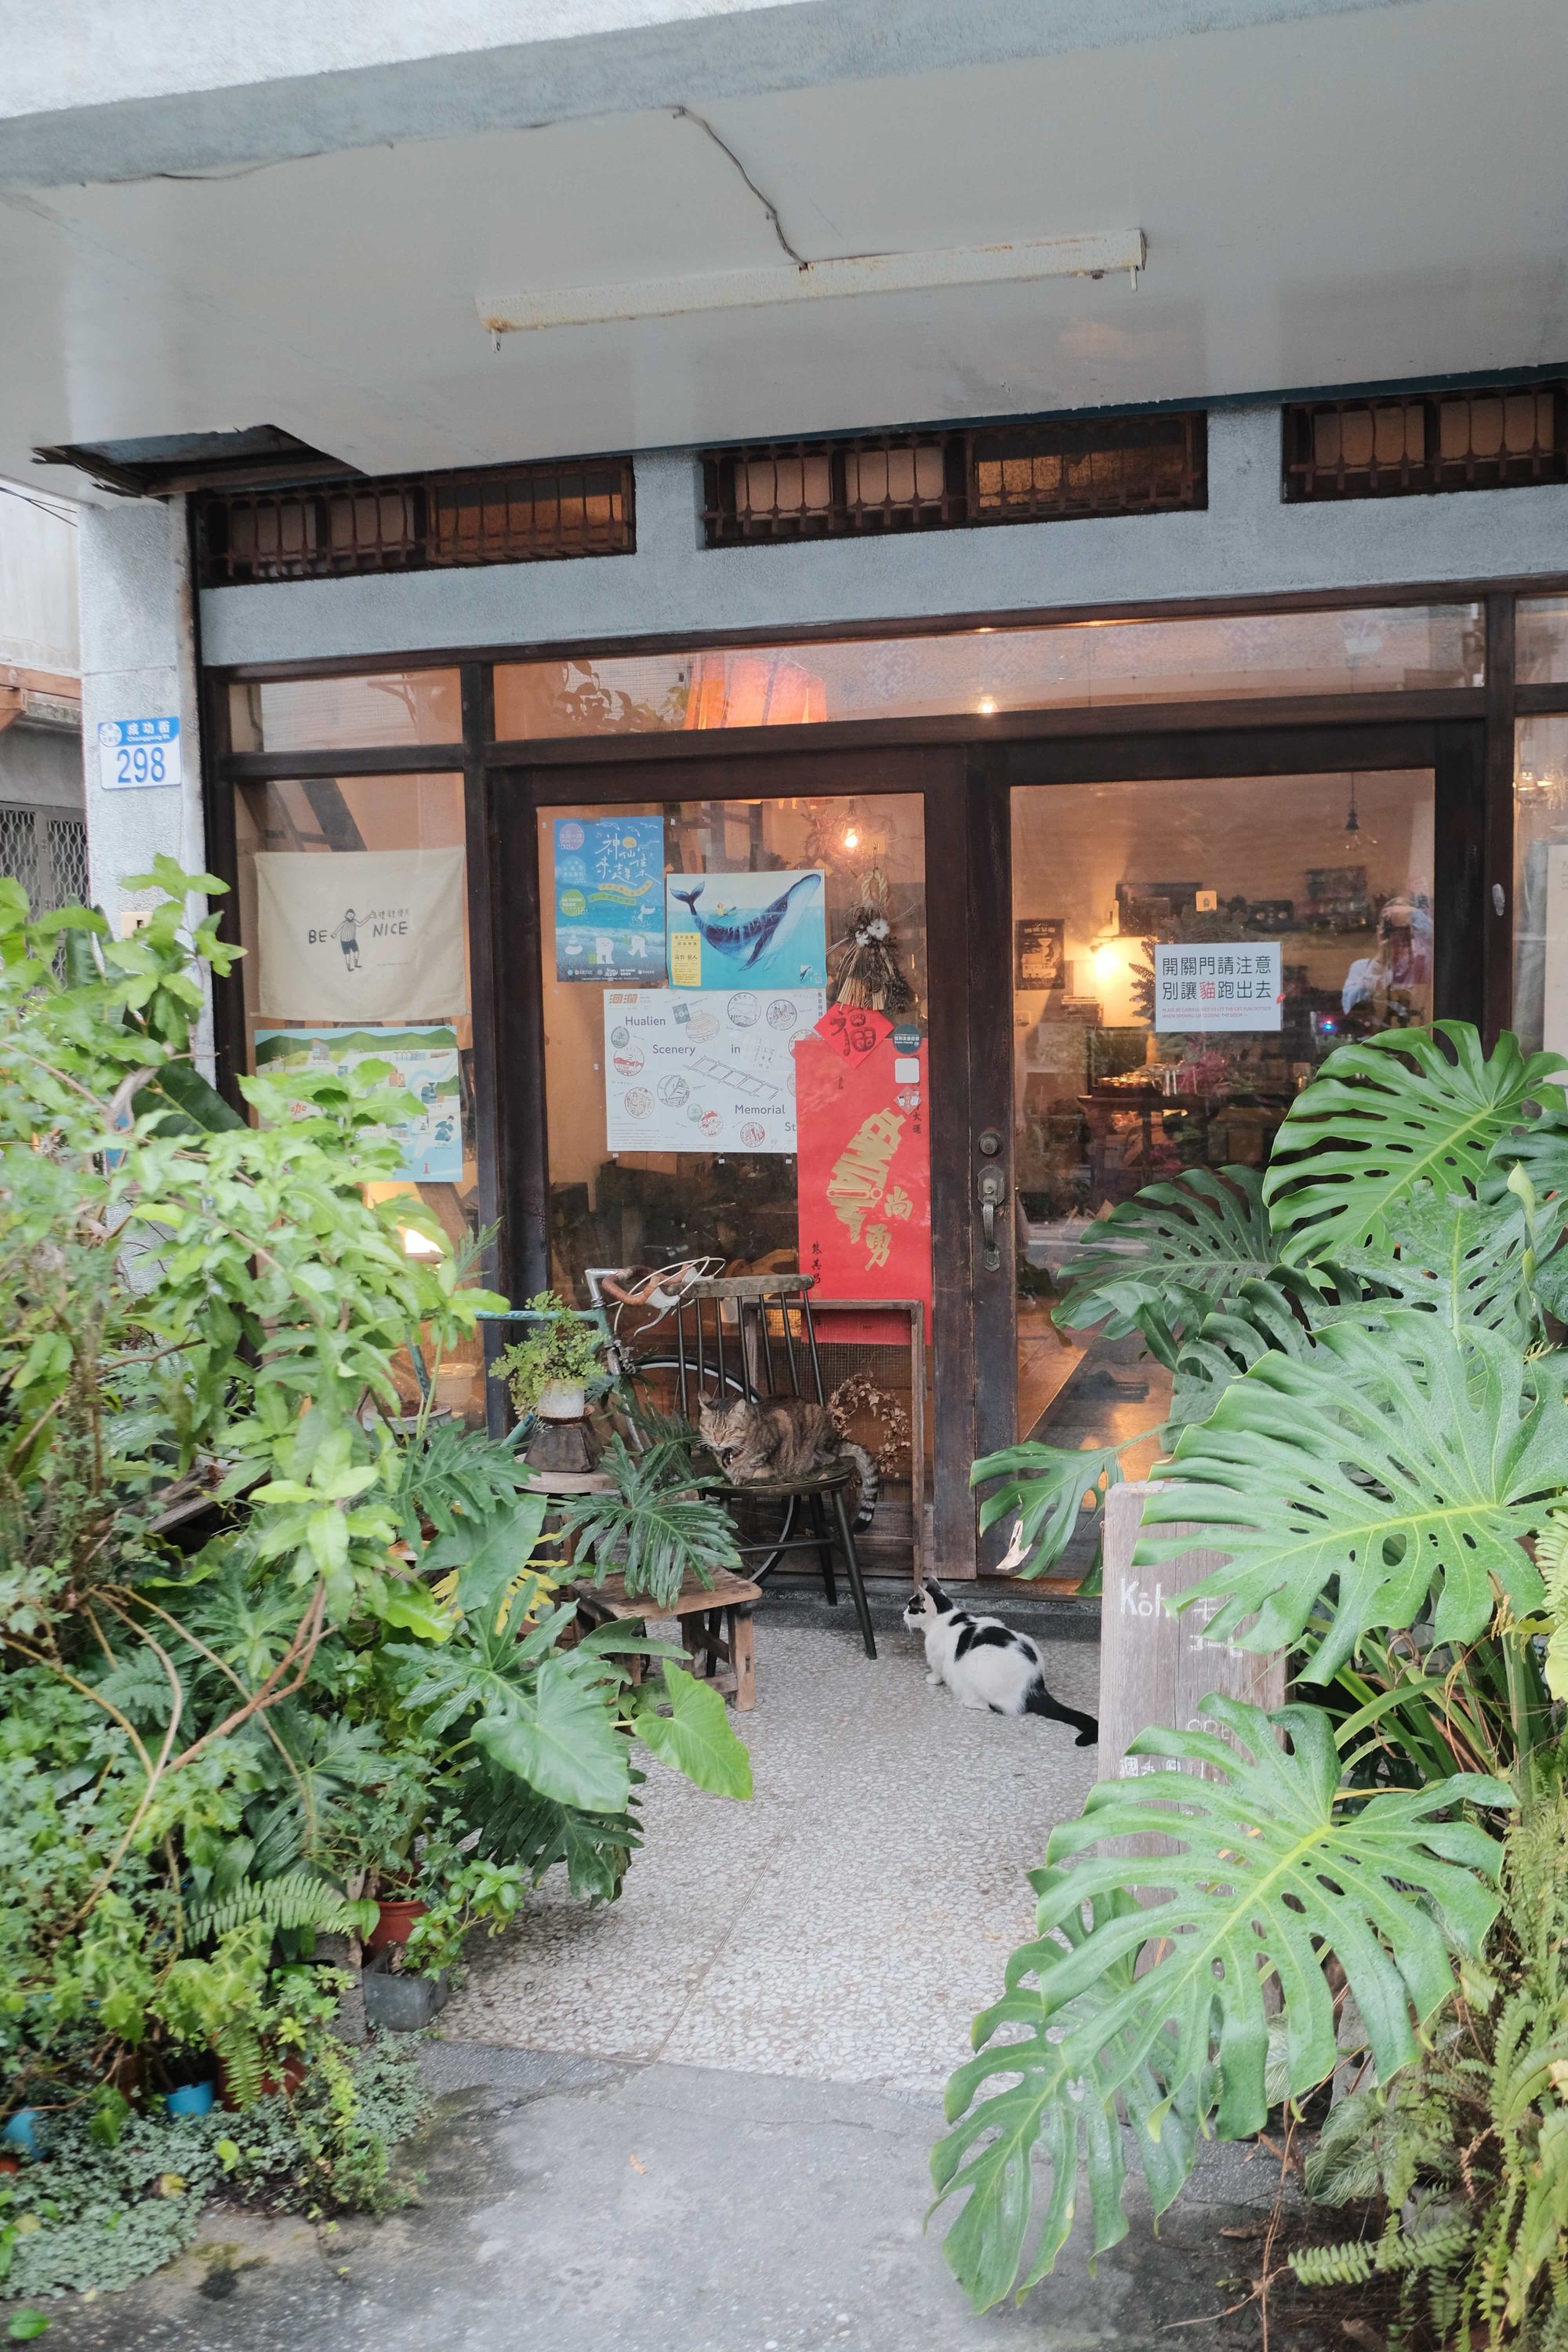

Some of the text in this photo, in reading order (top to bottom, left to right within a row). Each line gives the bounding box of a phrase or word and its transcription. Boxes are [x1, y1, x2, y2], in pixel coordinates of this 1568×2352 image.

[117, 747, 165, 783] 298
[308, 920, 408, 945] BE NICE
[1162, 955, 1272, 976] 開關門請注意
[1162, 980, 1272, 1000] 別讓貓跑出去
[625, 1016, 666, 1026] Hualien
[829, 1009, 877, 1057] 福
[652, 1044, 741, 1057] Scenery in
[735, 1104, 786, 1115] Memorial
